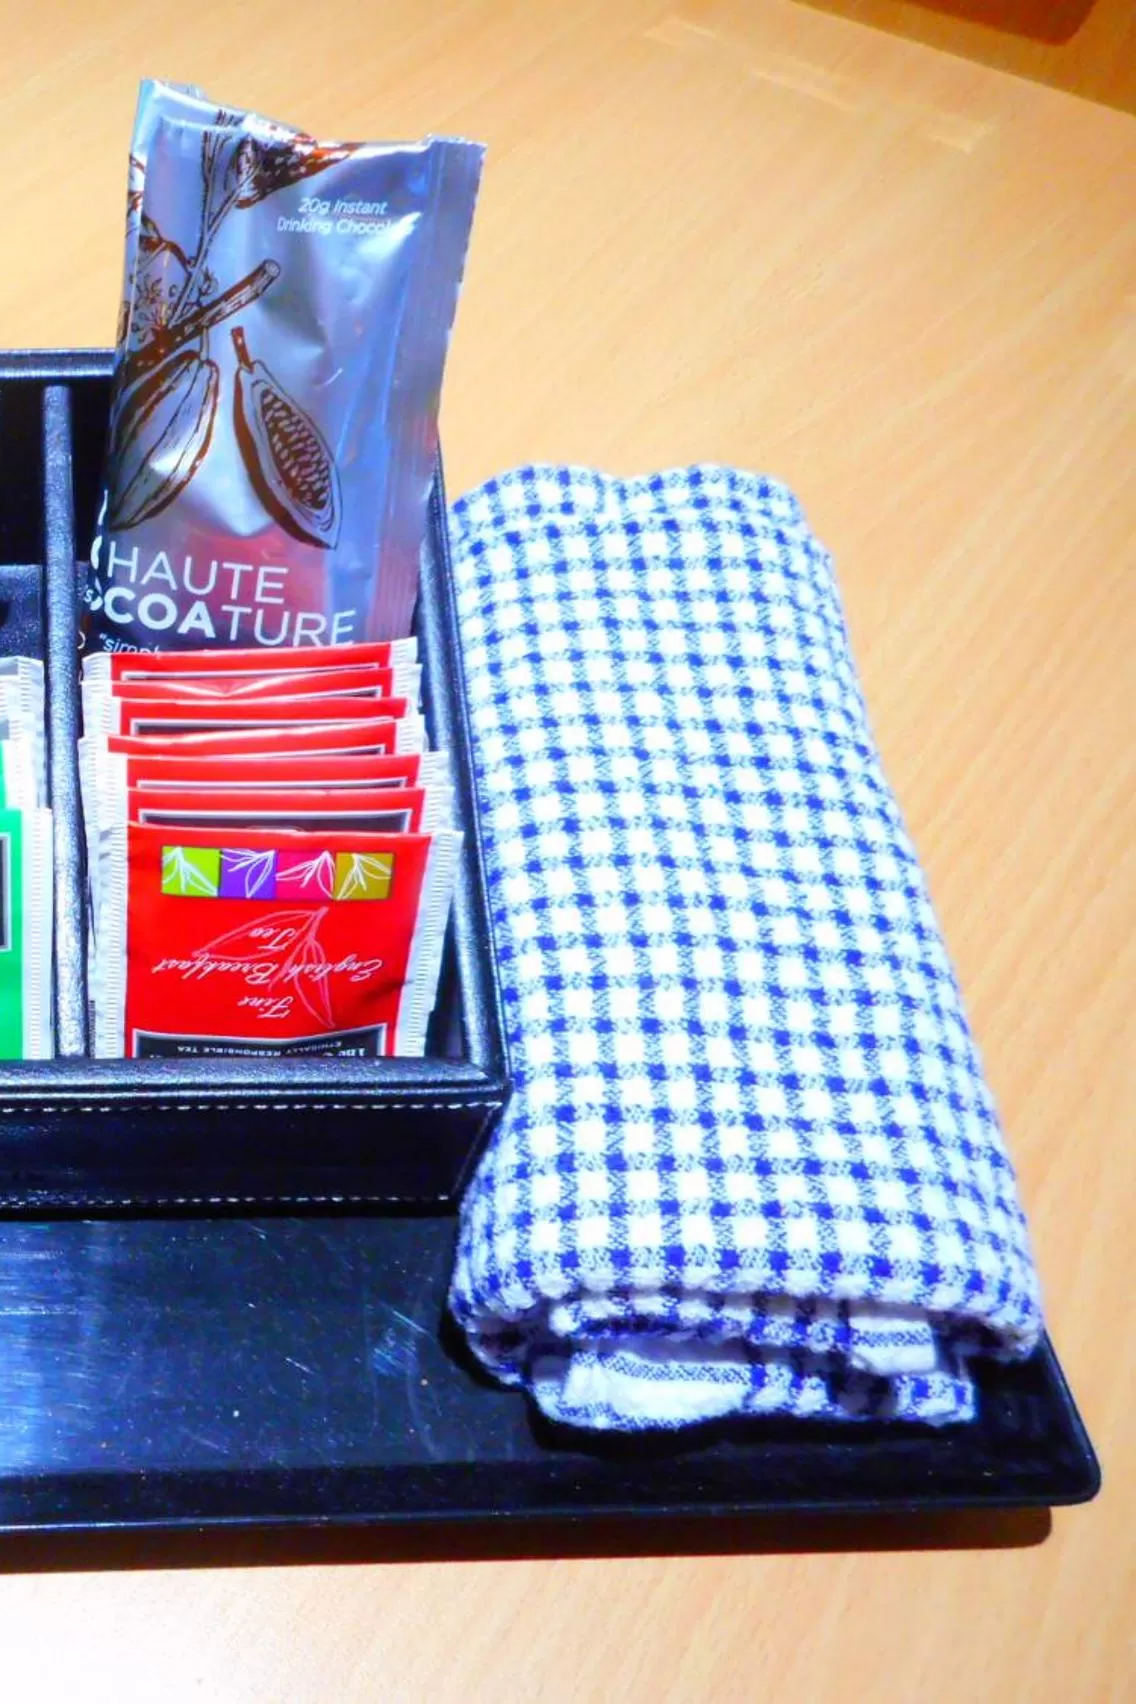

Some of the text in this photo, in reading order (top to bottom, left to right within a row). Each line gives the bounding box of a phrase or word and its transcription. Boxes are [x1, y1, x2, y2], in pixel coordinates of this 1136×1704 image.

[298, 198, 389, 215] 20g Instant
[276, 216, 333, 235] Drinking
[106, 541, 289, 604] HAUTE
[90, 577, 357, 648] COATURE
[249, 927, 296, 951] Tea
[152, 952, 383, 985] English Breakfast
[237, 995, 295, 1018] Fine
